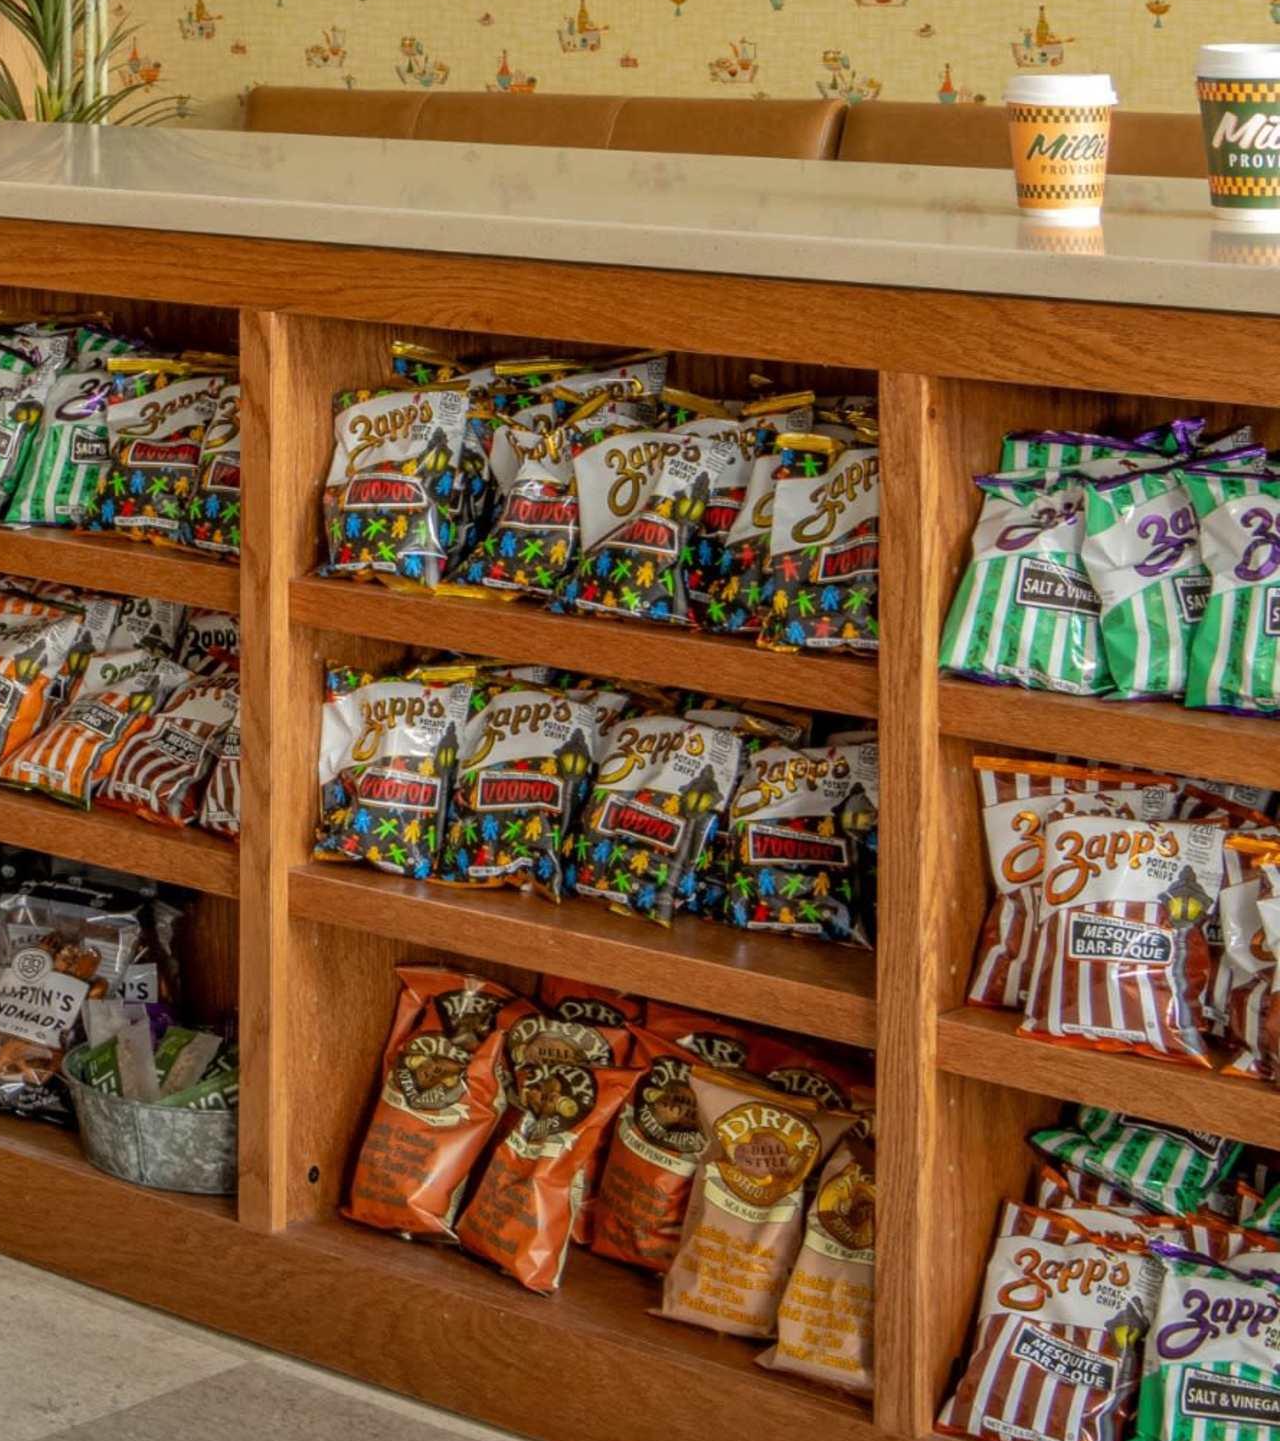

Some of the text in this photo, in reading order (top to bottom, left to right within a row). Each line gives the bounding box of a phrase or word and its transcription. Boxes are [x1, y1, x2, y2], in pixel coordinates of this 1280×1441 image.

[1024, 578, 1052, 595] SALT
[1054, 581, 1065, 597] &
[484, 782, 554, 802] VOODOO
[1043, 829, 1180, 905] Zapp's
[1146, 857, 1178, 872] POTATO
[1146, 869, 1175, 881] CHIPS
[1083, 925, 1161, 946] MESQUITE
[1076, 940, 1164, 960] BAR-B-QUE
[997, 1247, 1131, 1311] Zapp's
[1020, 1342, 1106, 1388] BAR-B-QUE
[1032, 1334, 1101, 1375] MESQUITE
[1187, 1388, 1280, 1411] SALT & VINEGA
